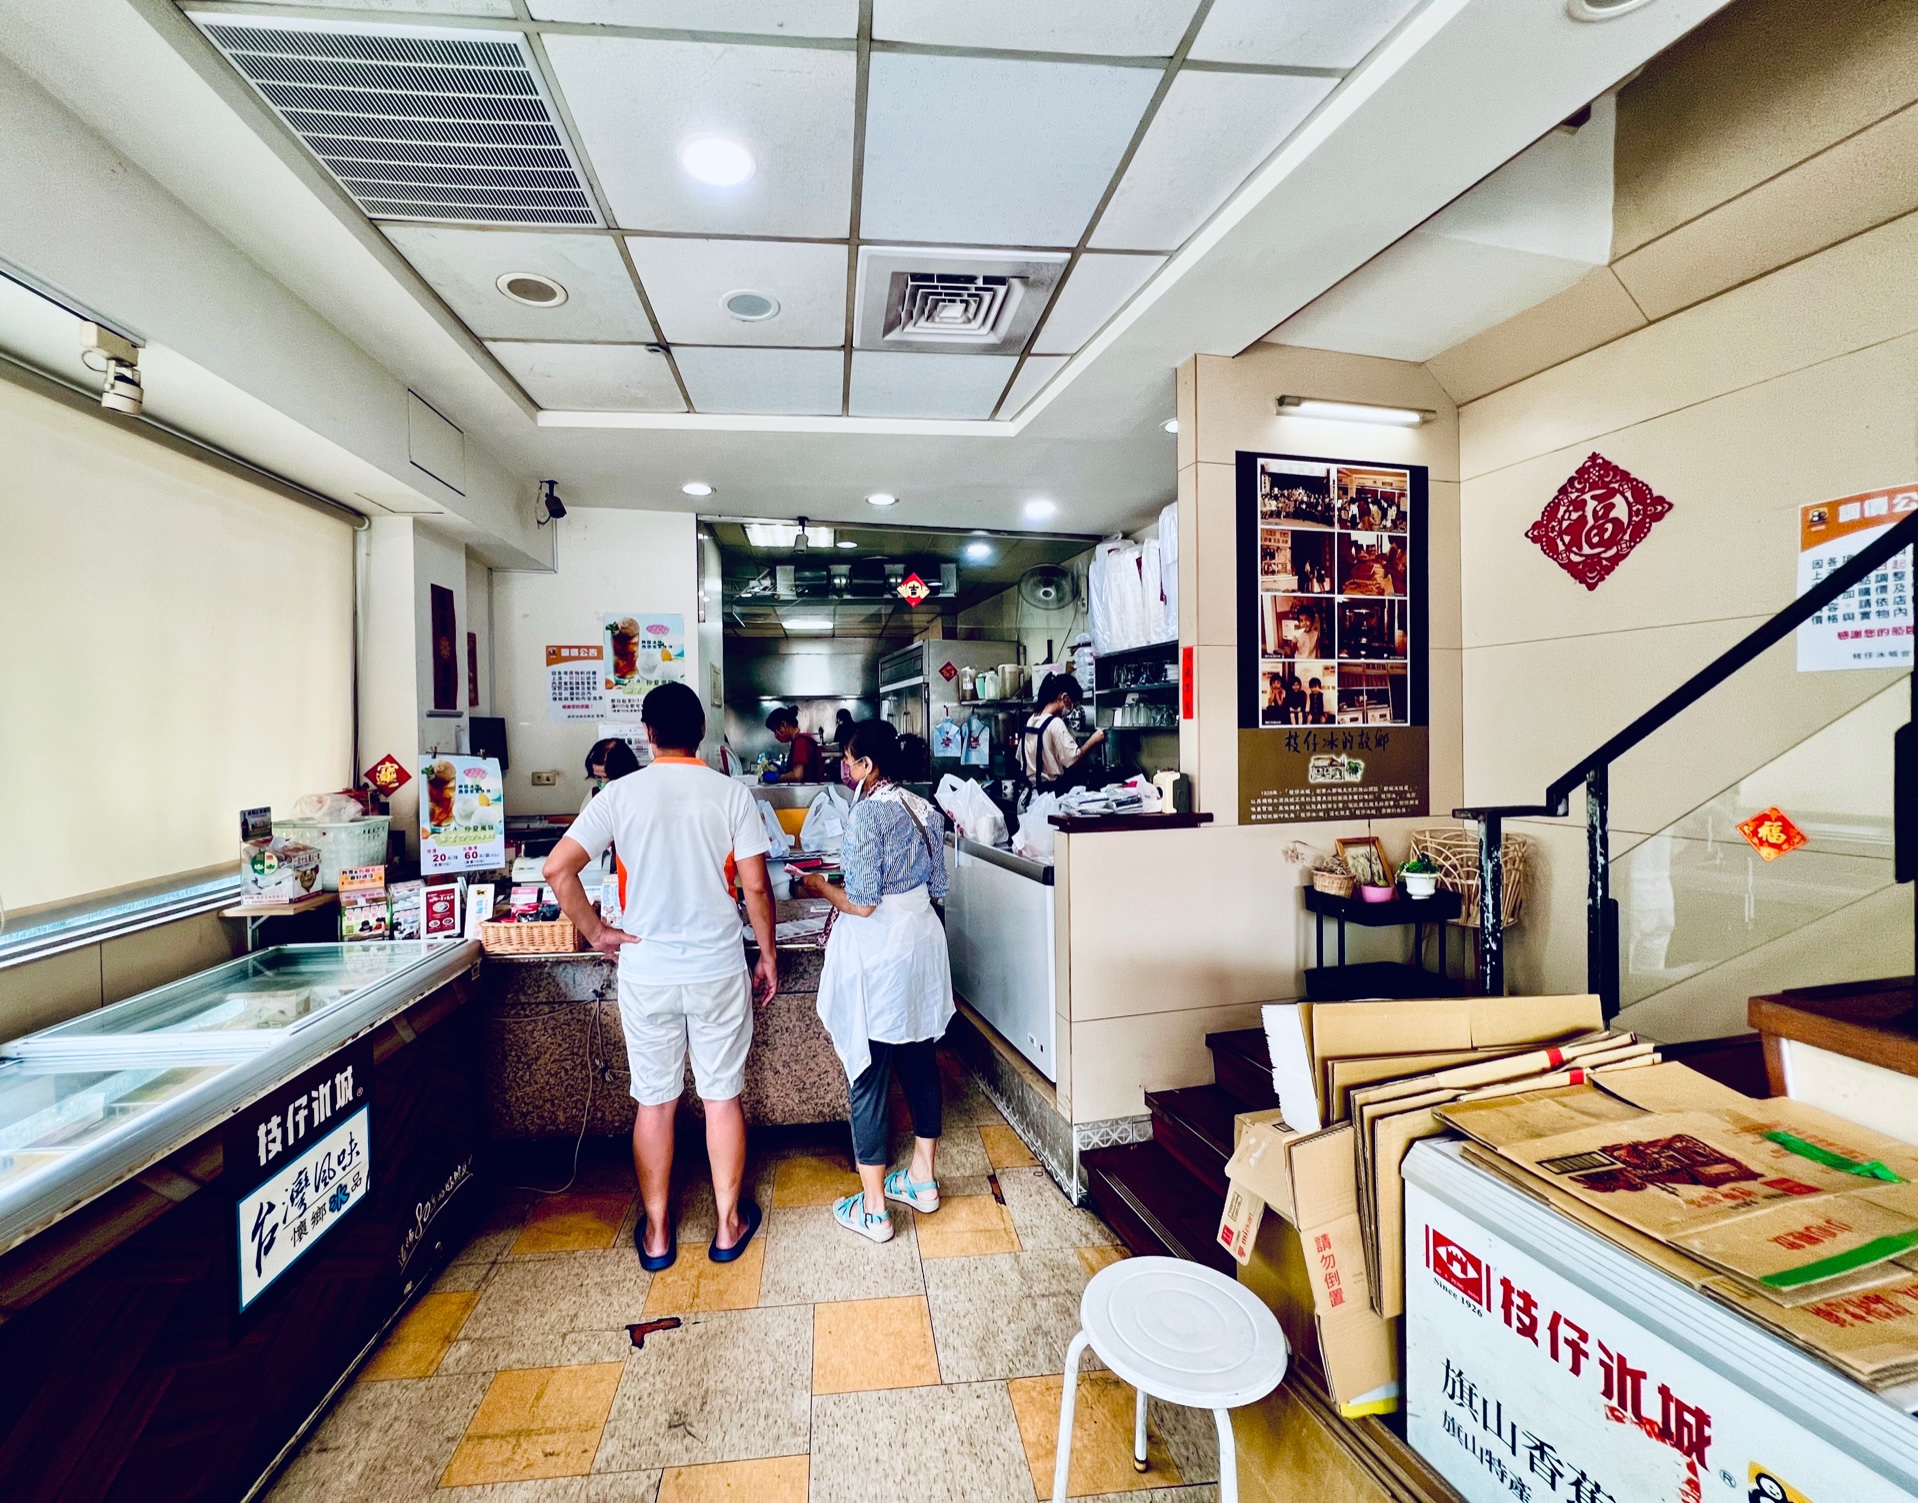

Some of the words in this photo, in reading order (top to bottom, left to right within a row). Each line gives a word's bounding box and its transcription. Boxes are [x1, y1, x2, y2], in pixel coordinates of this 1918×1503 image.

[1565, 486, 1627, 553] 福
[1758, 821, 1787, 844] 福
[433, 853, 446, 862] 20
[464, 851, 478, 859] 60
[251, 1131, 361, 1278] 台灣風味
[1314, 1233, 1345, 1308] 請勿倒置
[1434, 1277, 1458, 1299] Since
[1461, 1296, 1483, 1318] 1926
